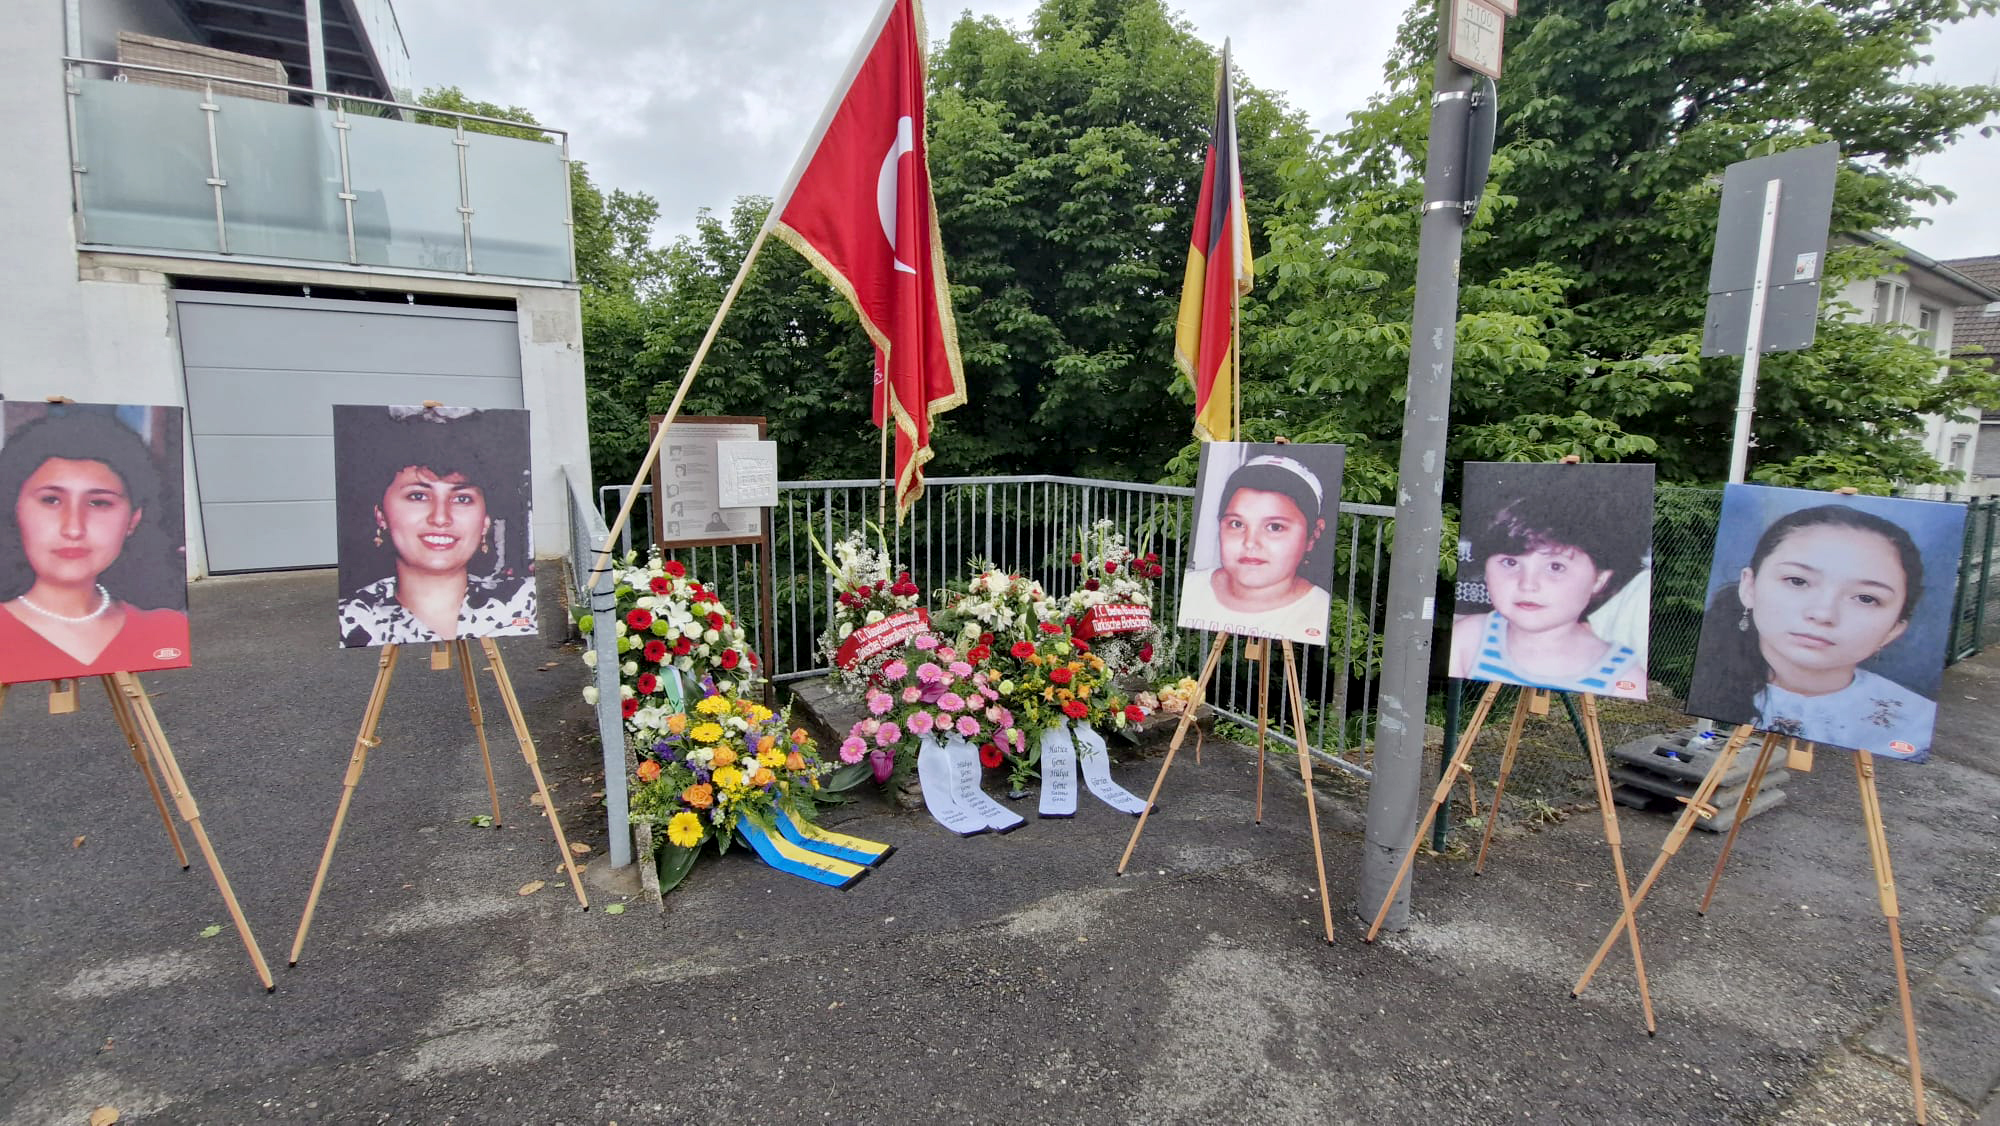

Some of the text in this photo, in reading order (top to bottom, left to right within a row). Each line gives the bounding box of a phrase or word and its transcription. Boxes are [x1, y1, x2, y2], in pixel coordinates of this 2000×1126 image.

[1466, 2, 1493, 27] H 100
[1092, 619, 1121, 632] Türkische
